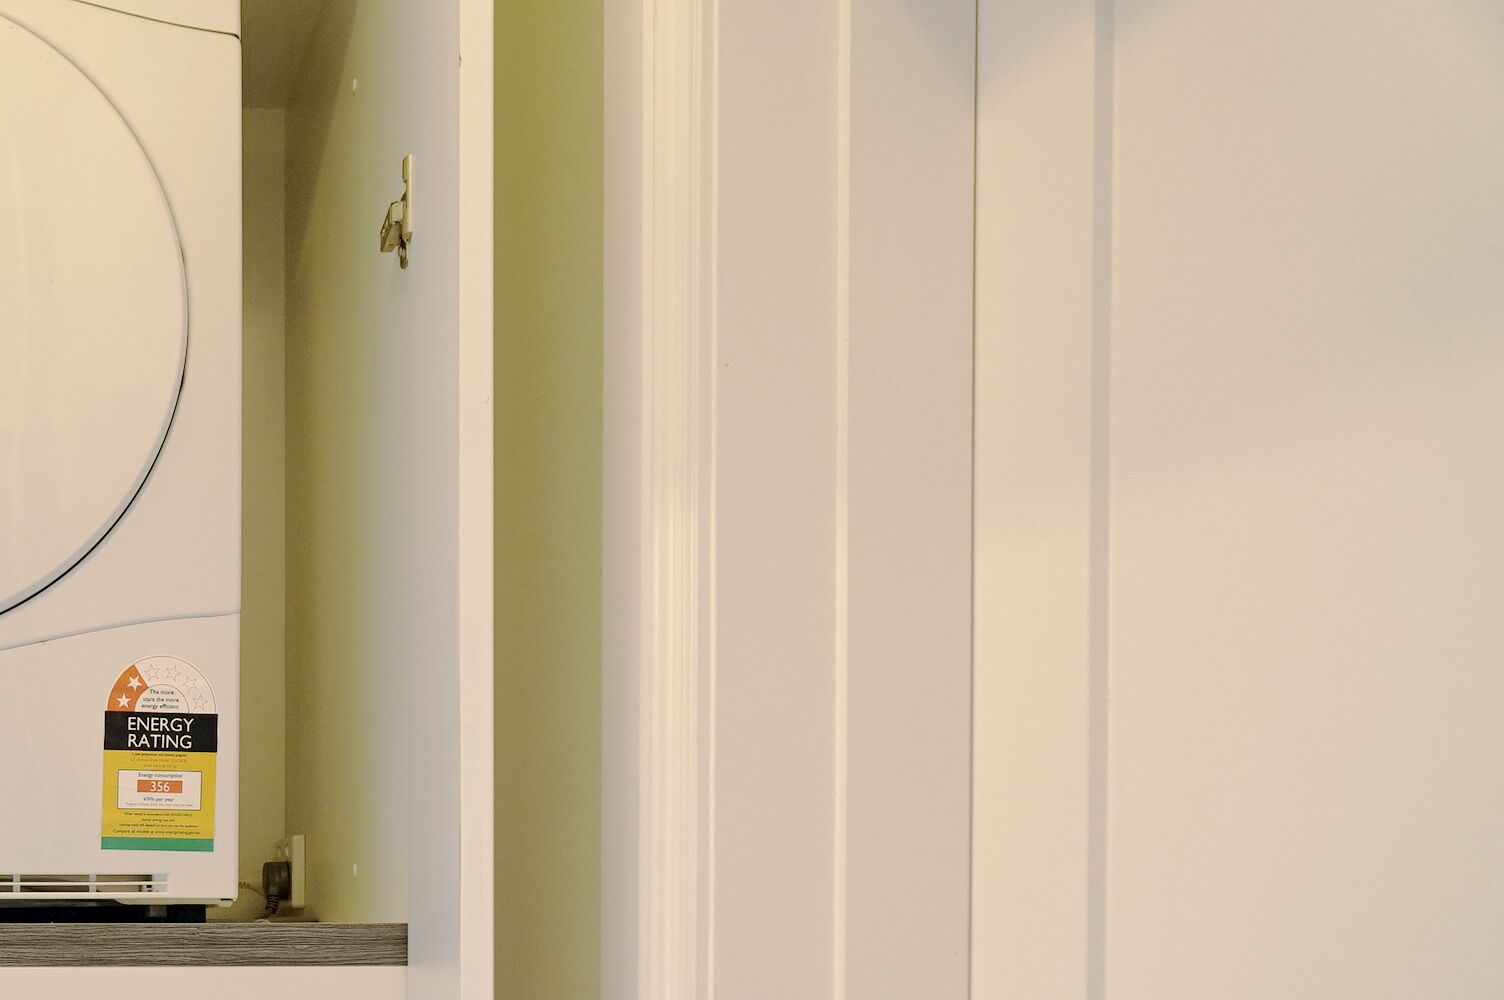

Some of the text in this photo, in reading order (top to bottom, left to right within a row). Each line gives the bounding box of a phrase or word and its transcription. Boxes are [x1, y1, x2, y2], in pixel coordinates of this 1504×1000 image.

[127, 716, 194, 732] ENERGY
[127, 733, 192, 749] RATING
[149, 781, 170, 793] 356
